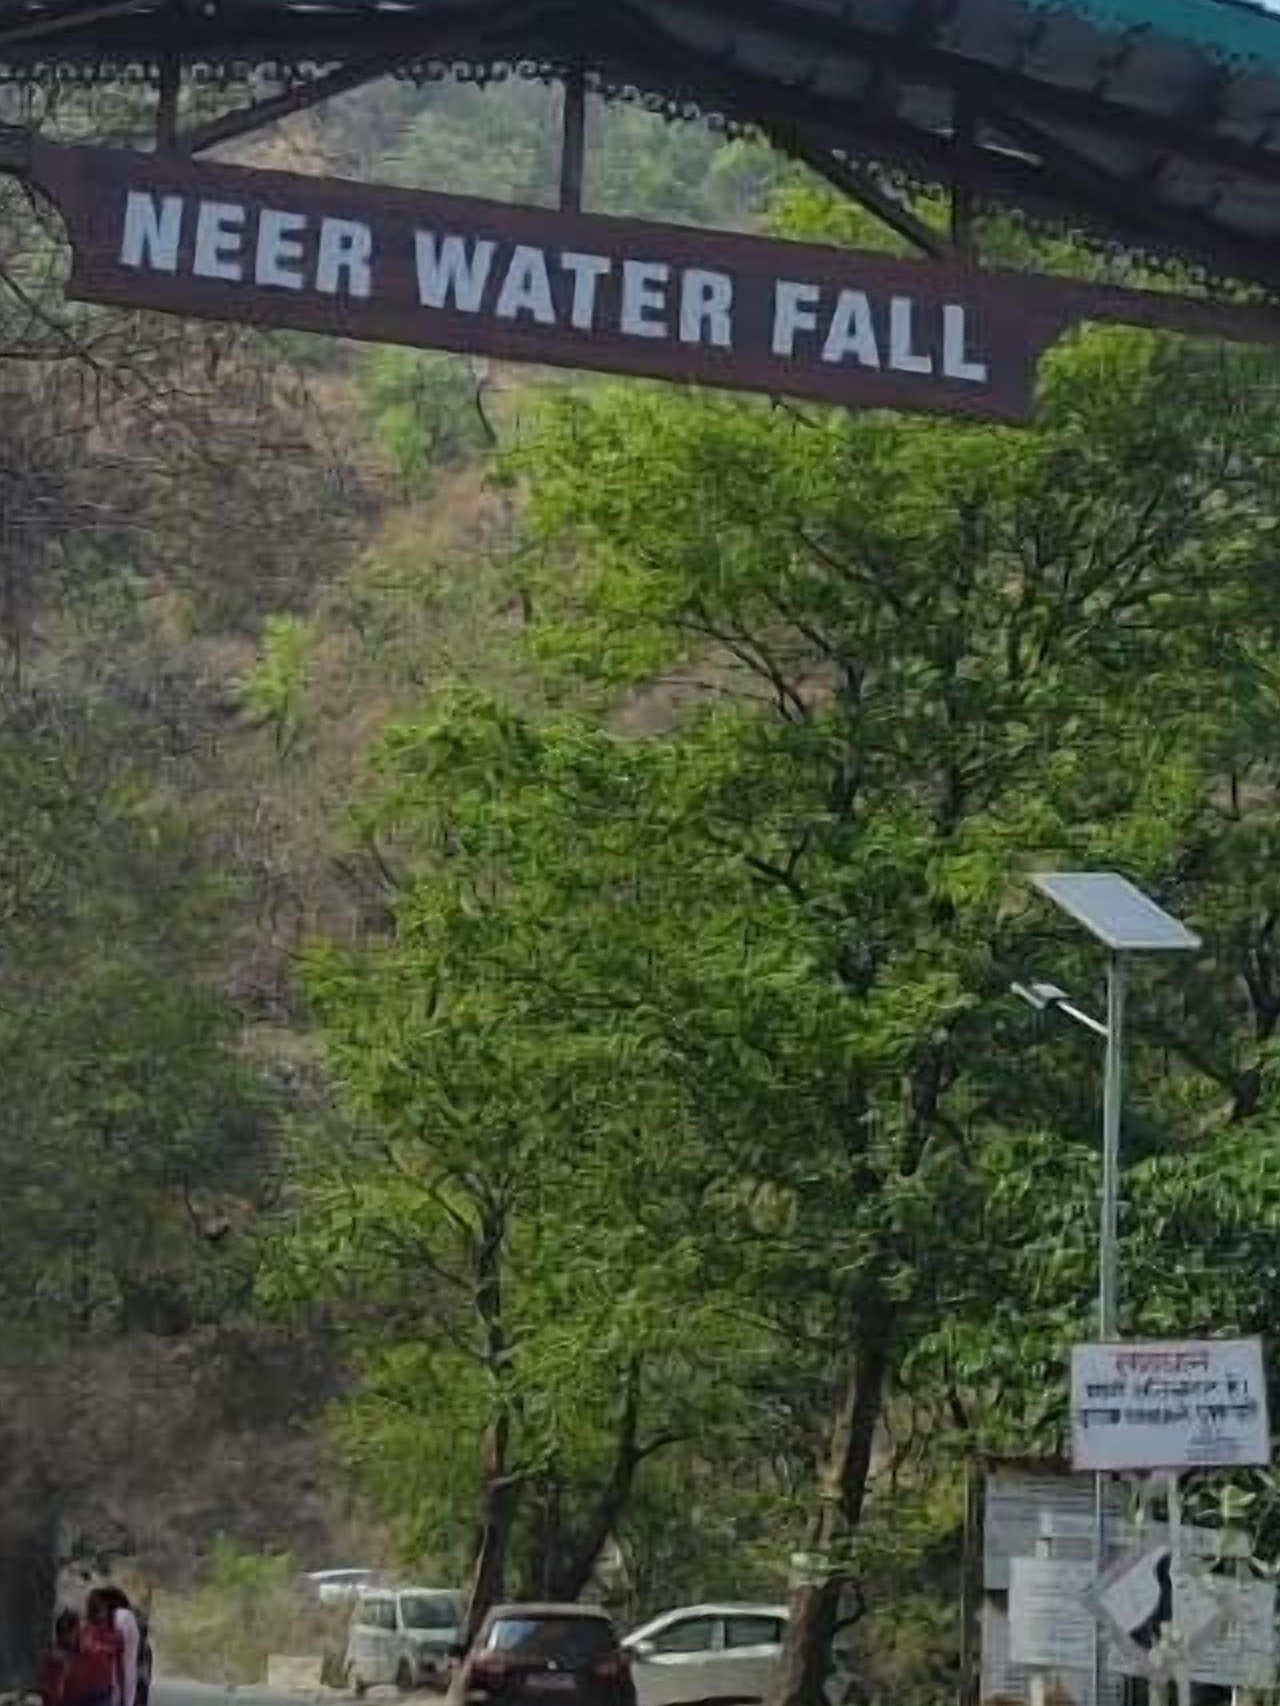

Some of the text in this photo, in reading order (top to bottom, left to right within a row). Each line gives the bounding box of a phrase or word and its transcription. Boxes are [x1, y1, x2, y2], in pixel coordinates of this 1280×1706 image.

[121, 190, 988, 383] NEER WATER FALL
